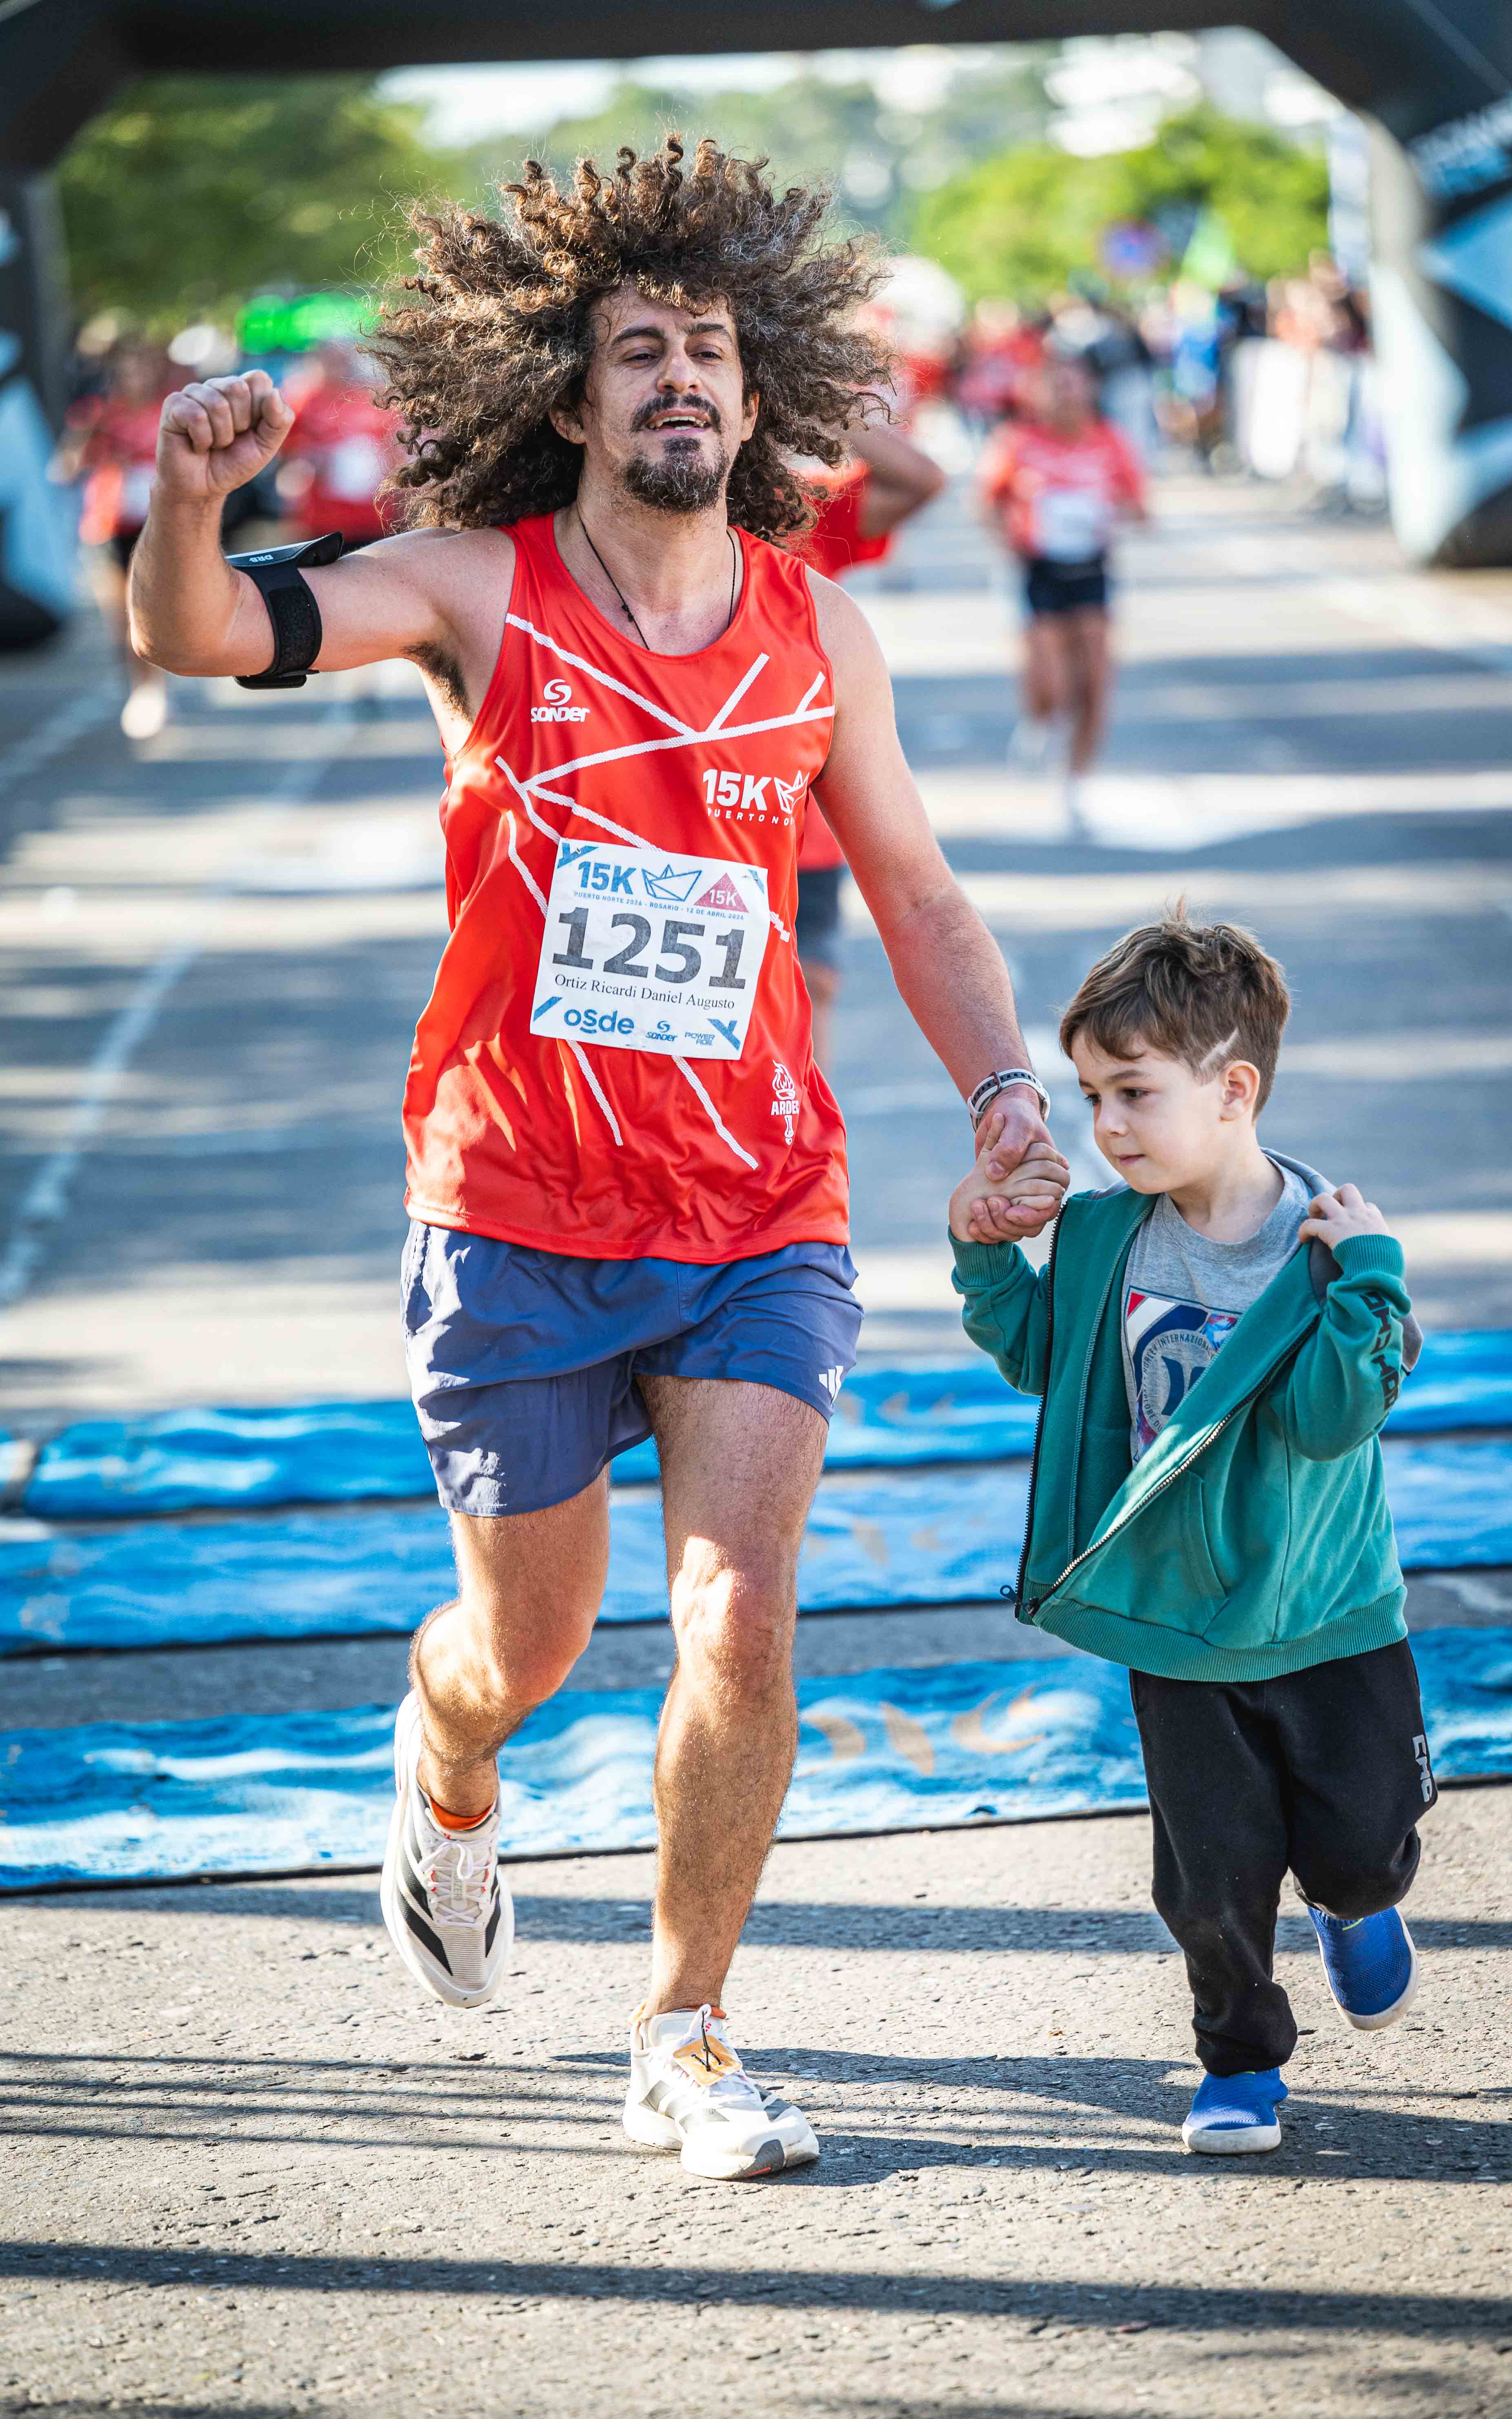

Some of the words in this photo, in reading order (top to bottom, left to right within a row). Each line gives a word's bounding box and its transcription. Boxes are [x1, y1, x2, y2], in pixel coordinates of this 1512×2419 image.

[703, 769, 771, 811] 15K
[578, 861, 637, 895] 15K
[574, 891, 601, 900] PUERTO
[650, 902, 678, 911] ROSARIO
[709, 889, 737, 907] 15K
[553, 906, 746, 989] 1251
[555, 974, 587, 989] Ortiz
[591, 980, 637, 997] Ricardi
[641, 987, 682, 1004] Daniel
[686, 994, 735, 1010] Augusto
[564, 1009, 634, 1034] osde
[1143, 1344, 1158, 1374] HURLEY
